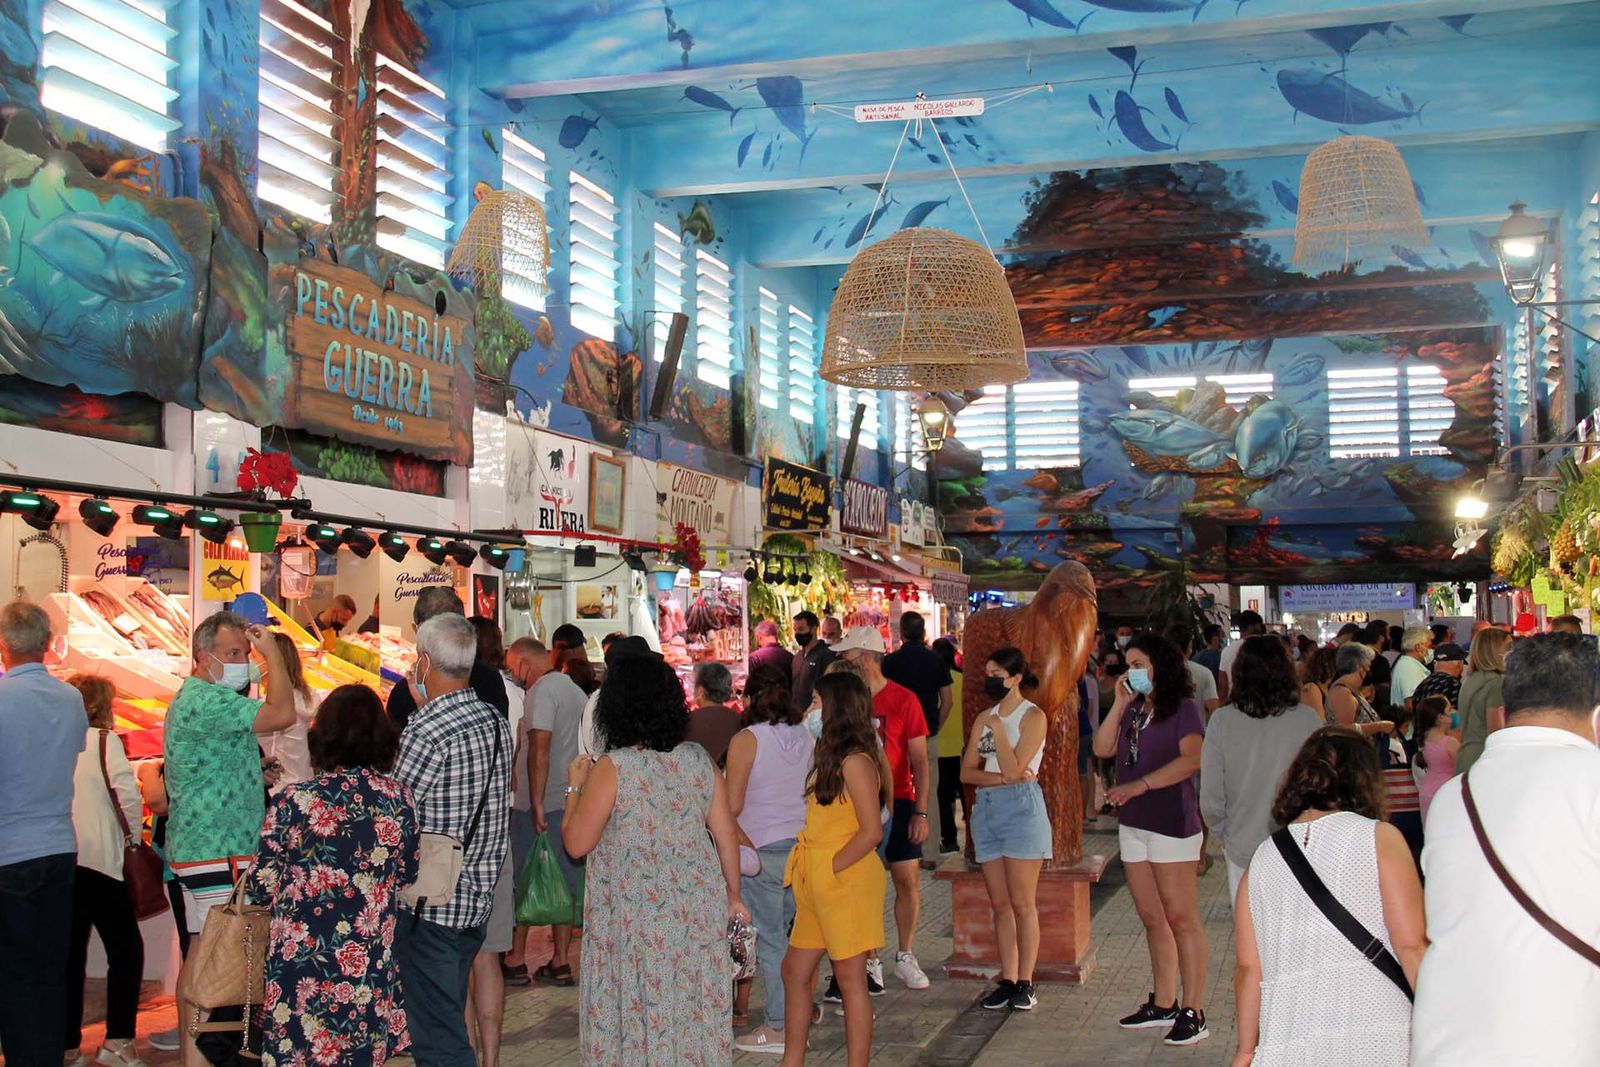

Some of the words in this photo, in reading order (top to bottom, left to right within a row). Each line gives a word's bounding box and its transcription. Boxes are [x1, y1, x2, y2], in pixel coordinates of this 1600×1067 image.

[323, 340, 433, 418] GUERRA
[352, 404, 379, 425] Desde
[203, 541, 222, 560] COLA
